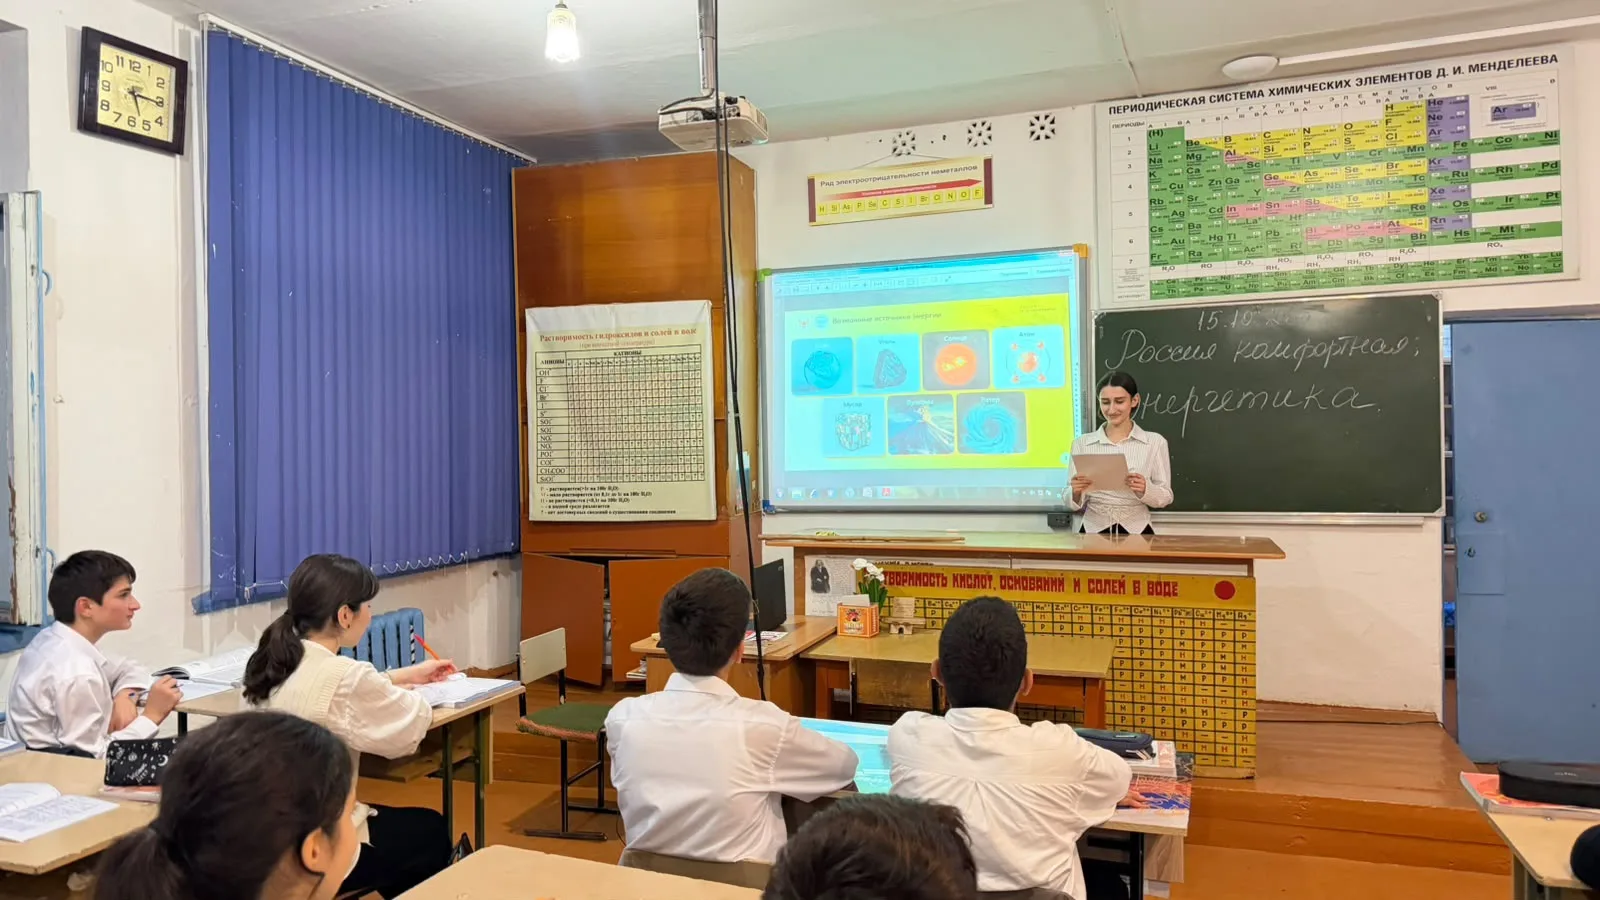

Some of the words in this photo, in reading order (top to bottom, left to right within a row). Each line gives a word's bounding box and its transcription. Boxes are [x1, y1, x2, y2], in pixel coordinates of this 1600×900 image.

[116, 55, 124, 68] 11
[129, 60, 141, 72] 12
[101, 60, 113, 73] 10
[157, 77, 165, 88] 2
[1109, 96, 1206, 115] ПЕРИОДИЧЕСКАЯ
[1209, 89, 1264, 104] СИСТЕМА
[1268, 79, 1351, 97] ХИМИЧЕСКИХ
[1355, 69, 1432, 86] ЭЛЕМЕНТОВ
[1436, 68, 1449, 78] Д.
[1453, 65, 1464, 75] И.
[1469, 54, 1558, 73] МЕНДЕЛЕЕВА
[102, 80, 110, 92] 9
[155, 96, 164, 107] 3
[100, 100, 110, 111] 8
[154, 116, 163, 127] 4
[113, 111, 122, 123] 7
[127, 116, 136, 127] 6
[142, 120, 151, 131] 5
[1112, 121, 1145, 129] ПЕРИОДЫ
[1386, 118, 1392, 126] F
[1407, 145, 1424, 153] Mn
[1495, 136, 1512, 144] Co
[1186, 153, 1202, 161] Mg
[1542, 161, 1558, 169] Pd
[835, 170, 929, 186] электроотрицательности
[1170, 209, 1185, 218] Ag
[1410, 203, 1425, 211] Re
[1209, 234, 1224, 242] Hg
[1454, 229, 1470, 237] Hs
[540, 334, 593, 342] Растворимость
[595, 331, 642, 340] гидроксидов
[651, 328, 672, 336] солей
[1105, 329, 1217, 370] Россия
[866, 570, 947, 587] ТВОРИМОСТЬ
[1000, 574, 1065, 592] ОСНОВАНИЙ
[1073, 577, 1081, 593] И
[1087, 575, 1126, 594] СОЛЕЙ
[1133, 580, 1140, 595] В
[1147, 581, 1178, 597] ВОДЕ
